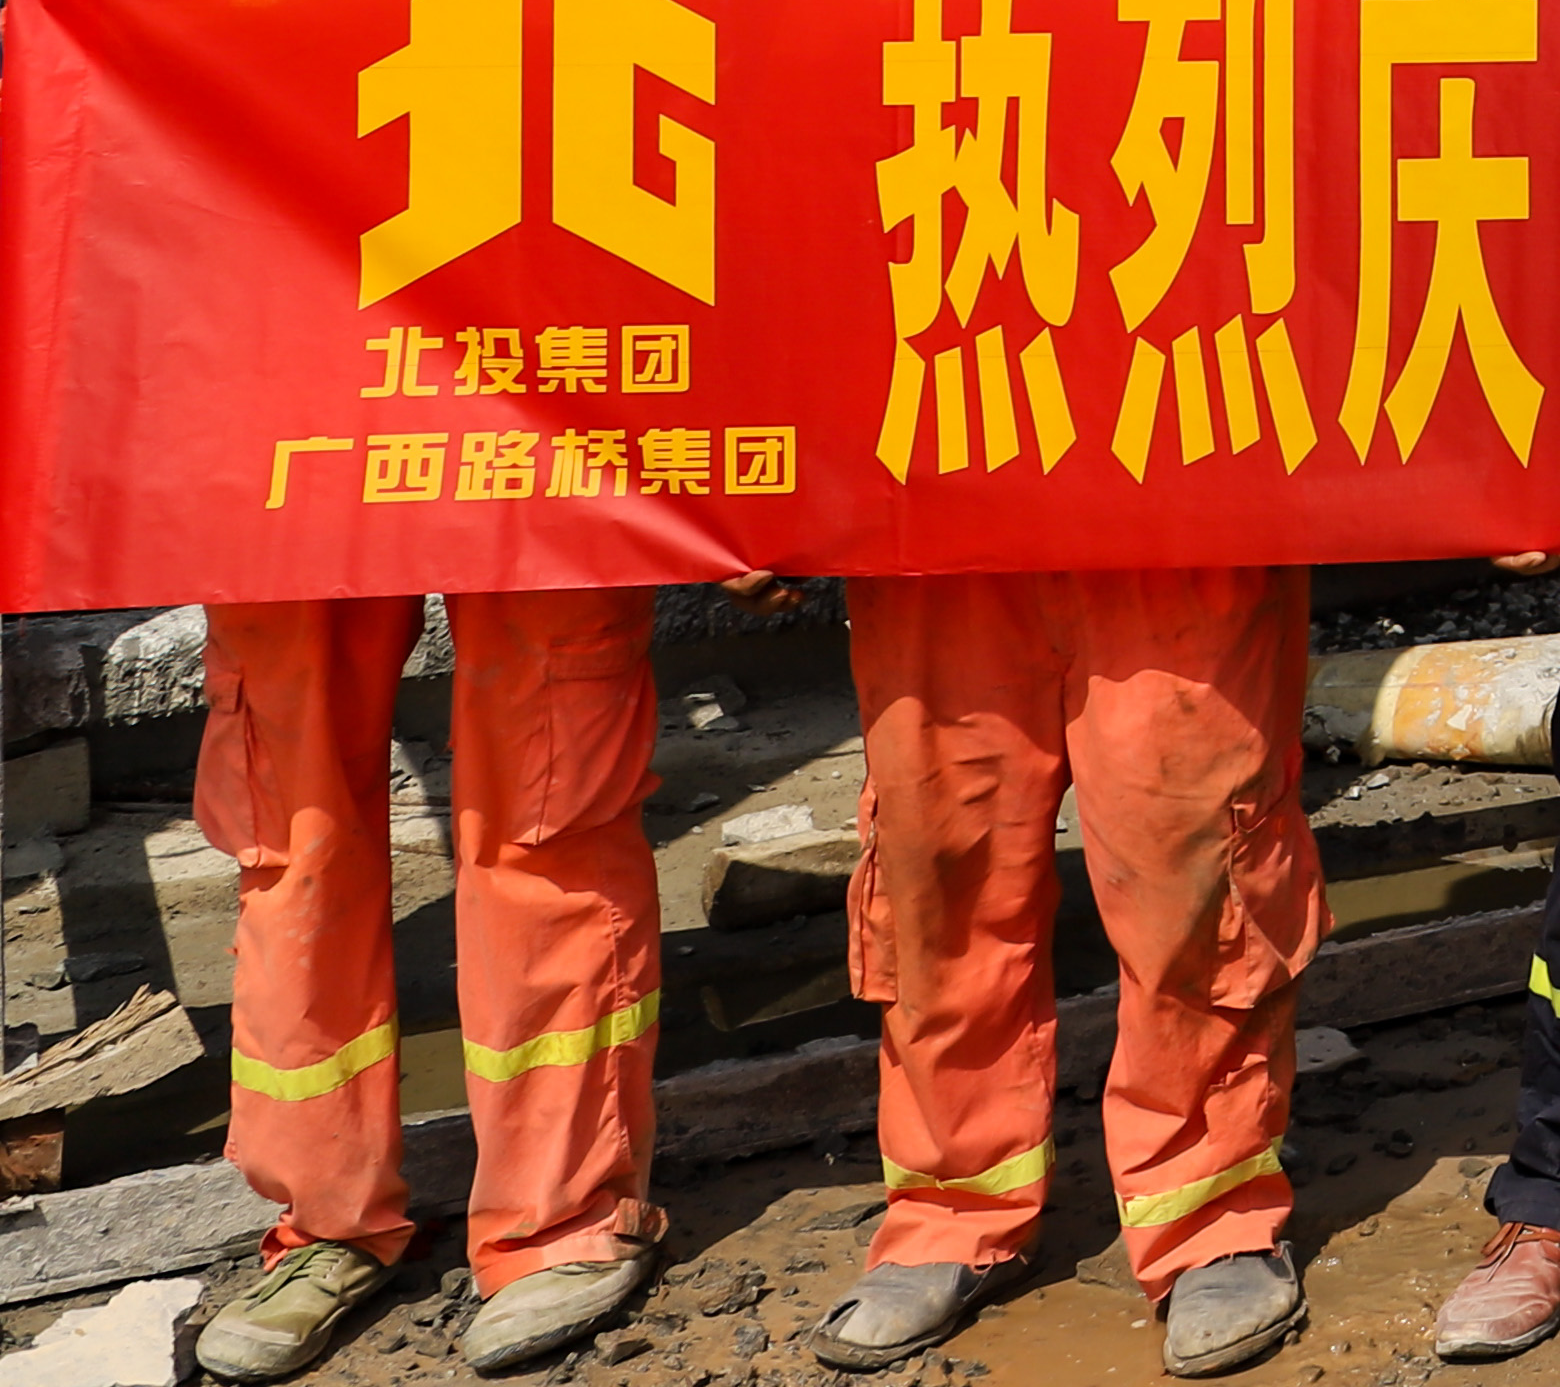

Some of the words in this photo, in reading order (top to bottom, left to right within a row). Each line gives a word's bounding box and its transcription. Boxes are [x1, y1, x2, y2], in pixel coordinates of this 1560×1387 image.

[361, 325, 691, 398] 北投集团
[266, 425, 796, 509] 广西路桥集团
